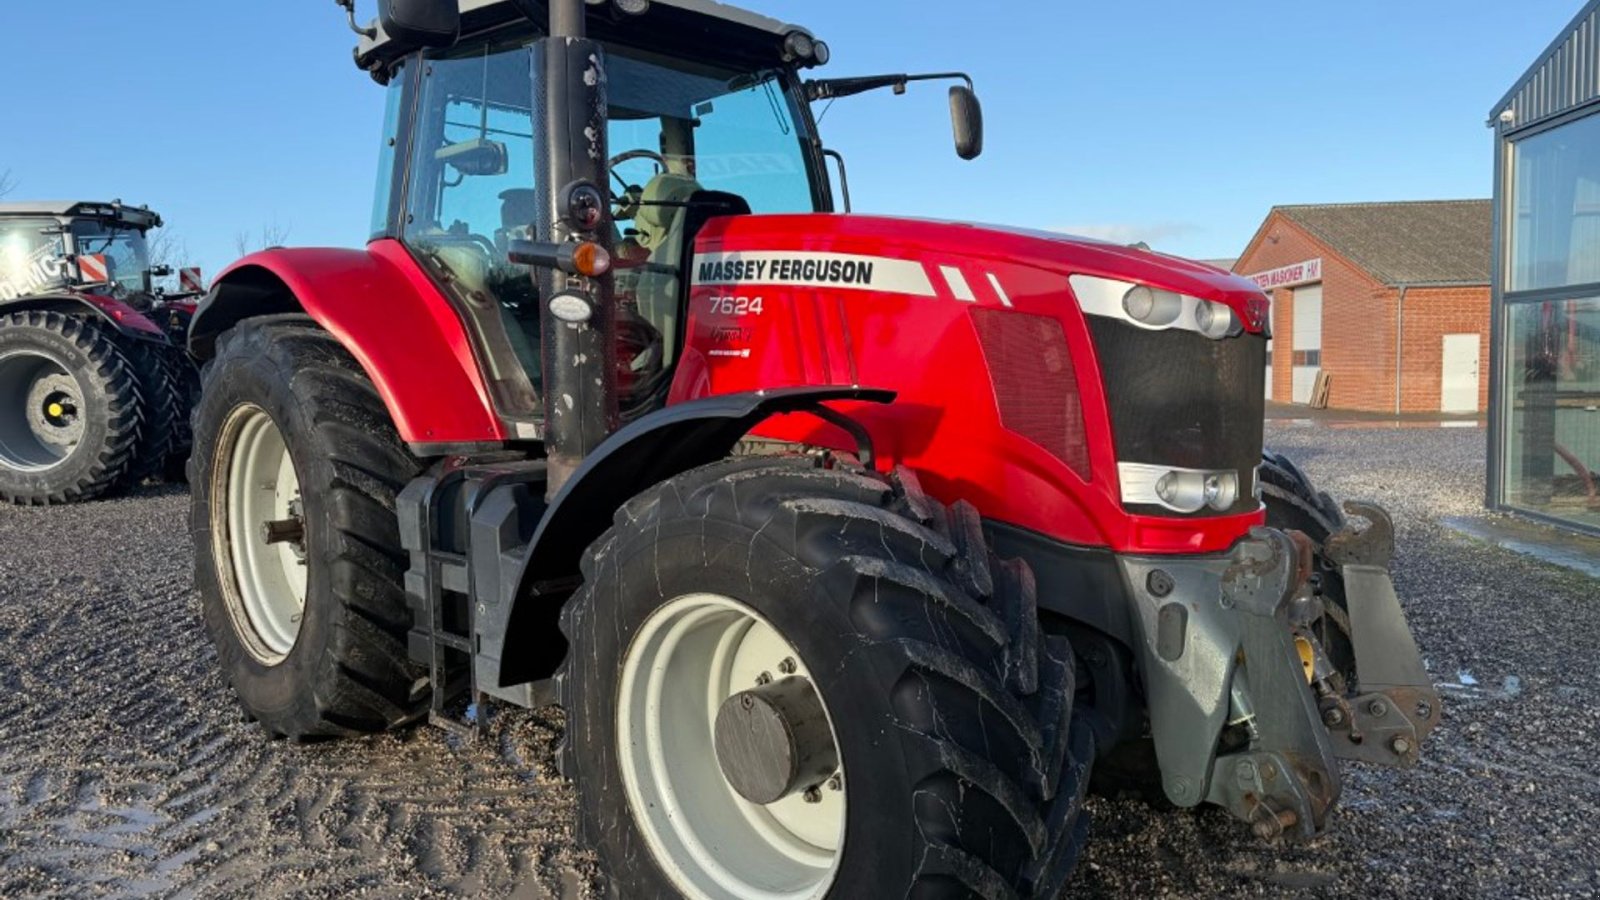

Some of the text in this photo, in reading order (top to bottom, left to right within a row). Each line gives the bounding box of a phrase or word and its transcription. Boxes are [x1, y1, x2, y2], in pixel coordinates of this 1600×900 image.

[699, 260, 873, 284] MASSEY FERGUSON
[709, 296, 763, 315] 7624
